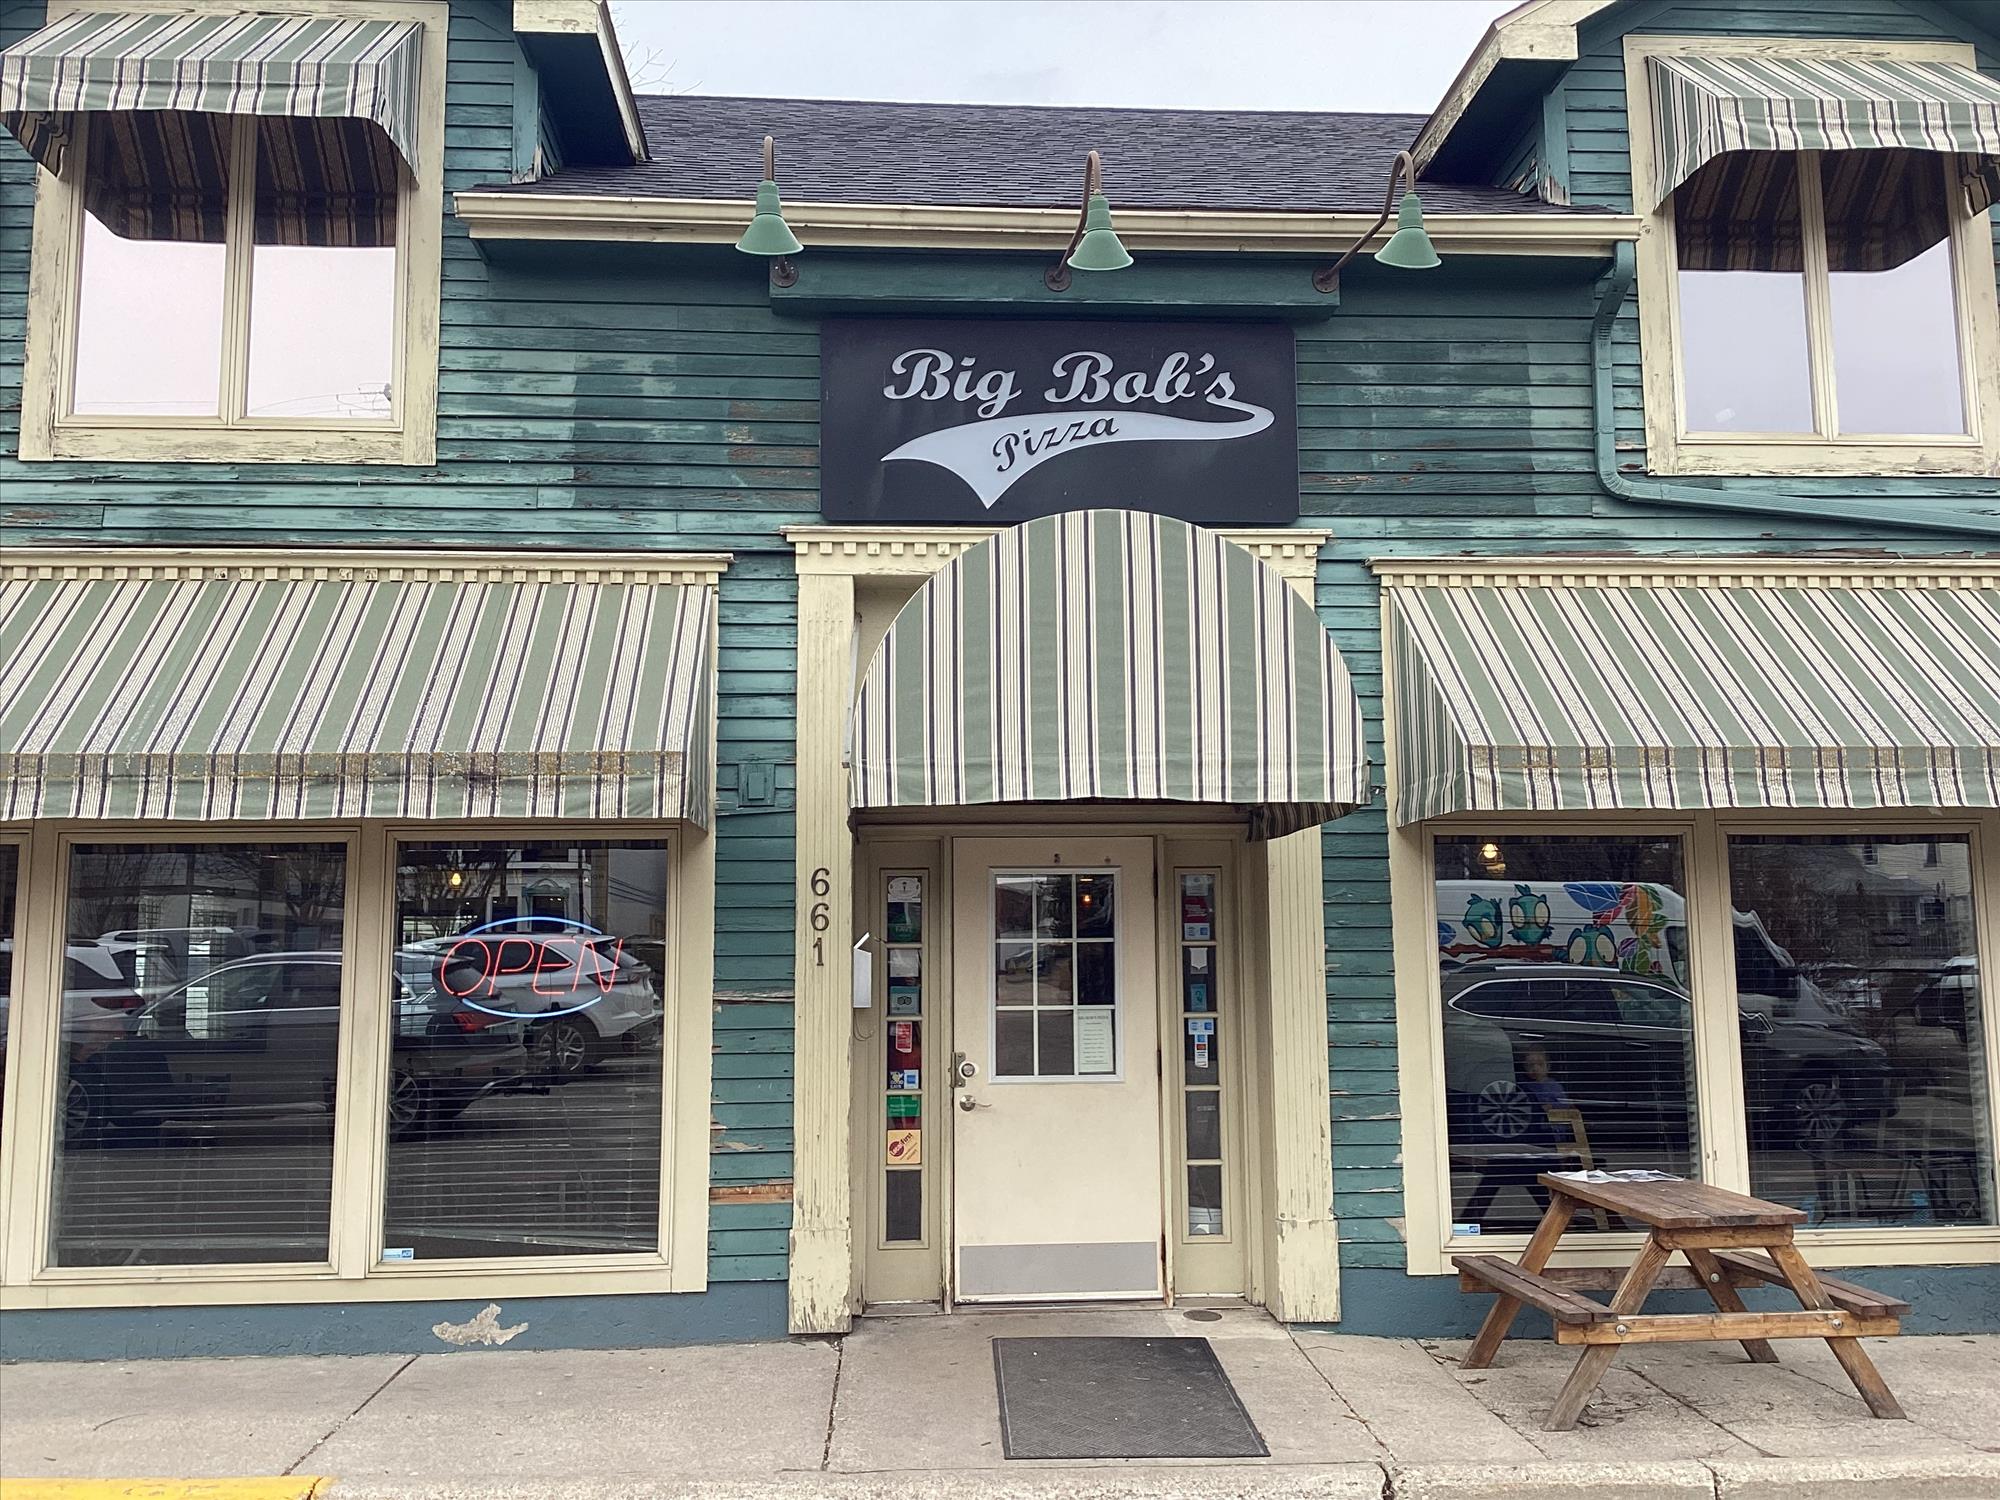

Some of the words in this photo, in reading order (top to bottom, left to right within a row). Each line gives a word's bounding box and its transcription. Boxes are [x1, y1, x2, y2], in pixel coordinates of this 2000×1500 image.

[882, 347, 1023, 419] Big
[1044, 350, 1237, 404] Bob's
[992, 416, 1120, 473] Pizza
[810, 867, 831, 967] 661
[440, 937, 625, 997] OPEN
